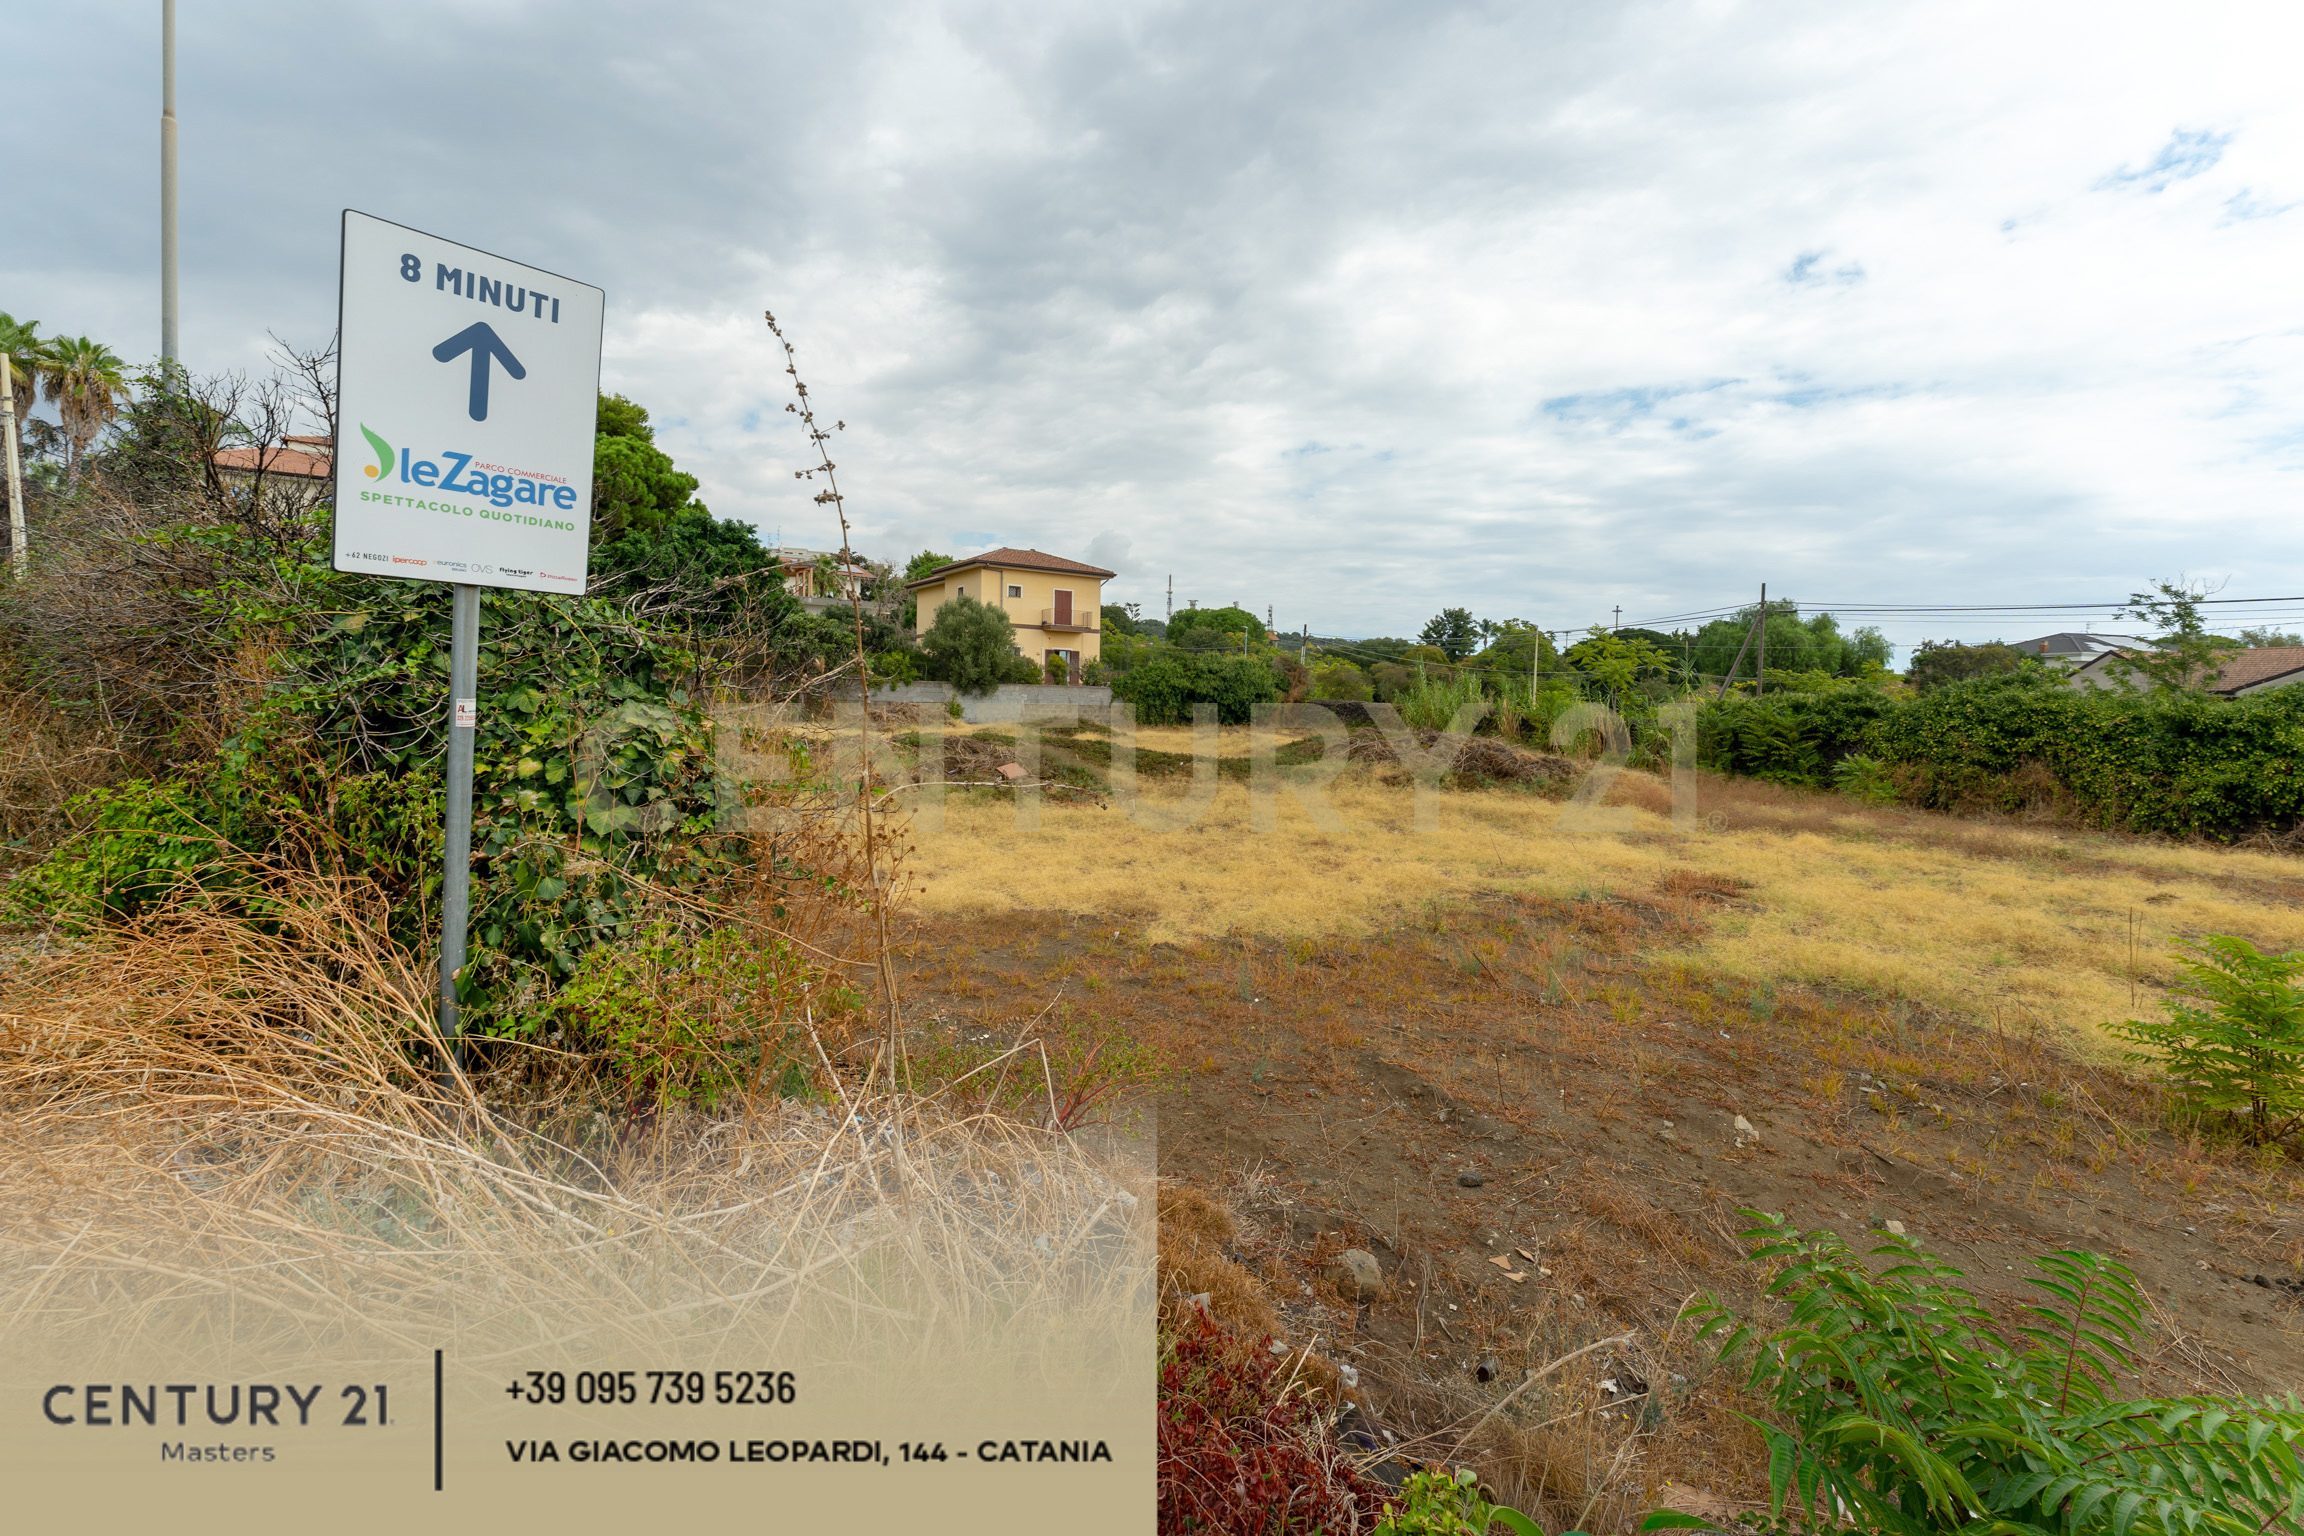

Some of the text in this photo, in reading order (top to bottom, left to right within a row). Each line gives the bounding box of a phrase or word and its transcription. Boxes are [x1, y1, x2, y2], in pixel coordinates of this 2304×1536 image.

[400, 253, 560, 324] 8 MINUTI
[474, 461, 568, 485] PARCO COMMERCIALE
[360, 491, 576, 532] SPETTACOLO QUOTIDIANO
[363, 552, 389, 562] NEGOZI
[392, 554, 428, 567] ipercoop
[436, 560, 468, 569] euronics
[470, 563, 494, 575] OVS
[499, 567, 517, 575] flying
[518, 568, 534, 576] tiger
